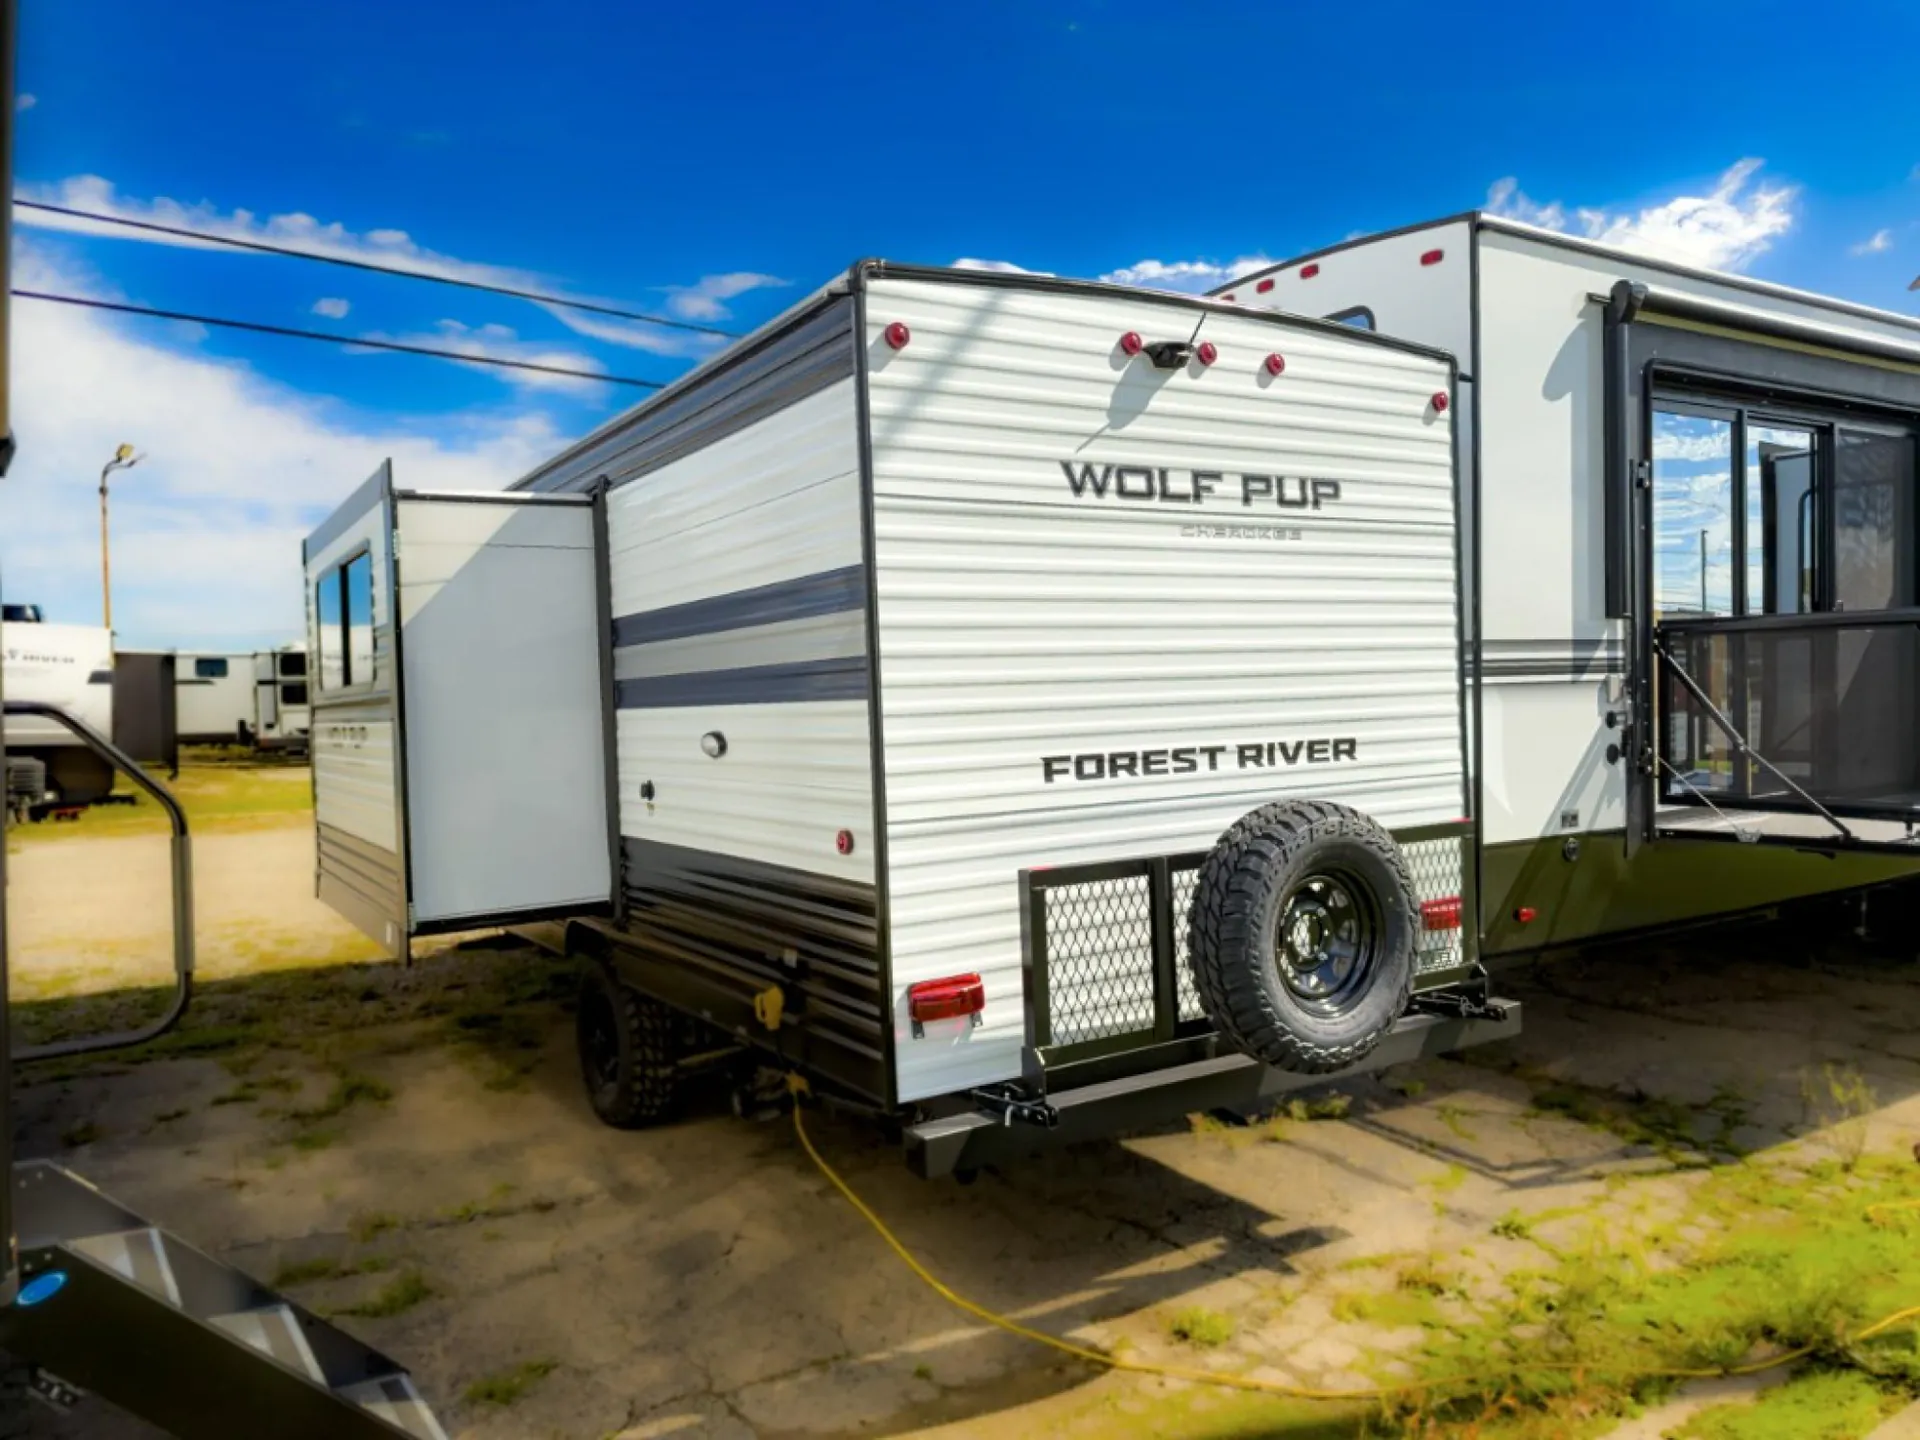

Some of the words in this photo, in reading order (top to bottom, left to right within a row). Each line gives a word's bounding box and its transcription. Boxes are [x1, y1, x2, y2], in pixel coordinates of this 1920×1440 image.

[1060, 460, 1222, 505] WOLF
[1241, 473, 1341, 510] PUP
[1040, 744, 1227, 783] FOREST
[1235, 737, 1357, 769] RIVER
